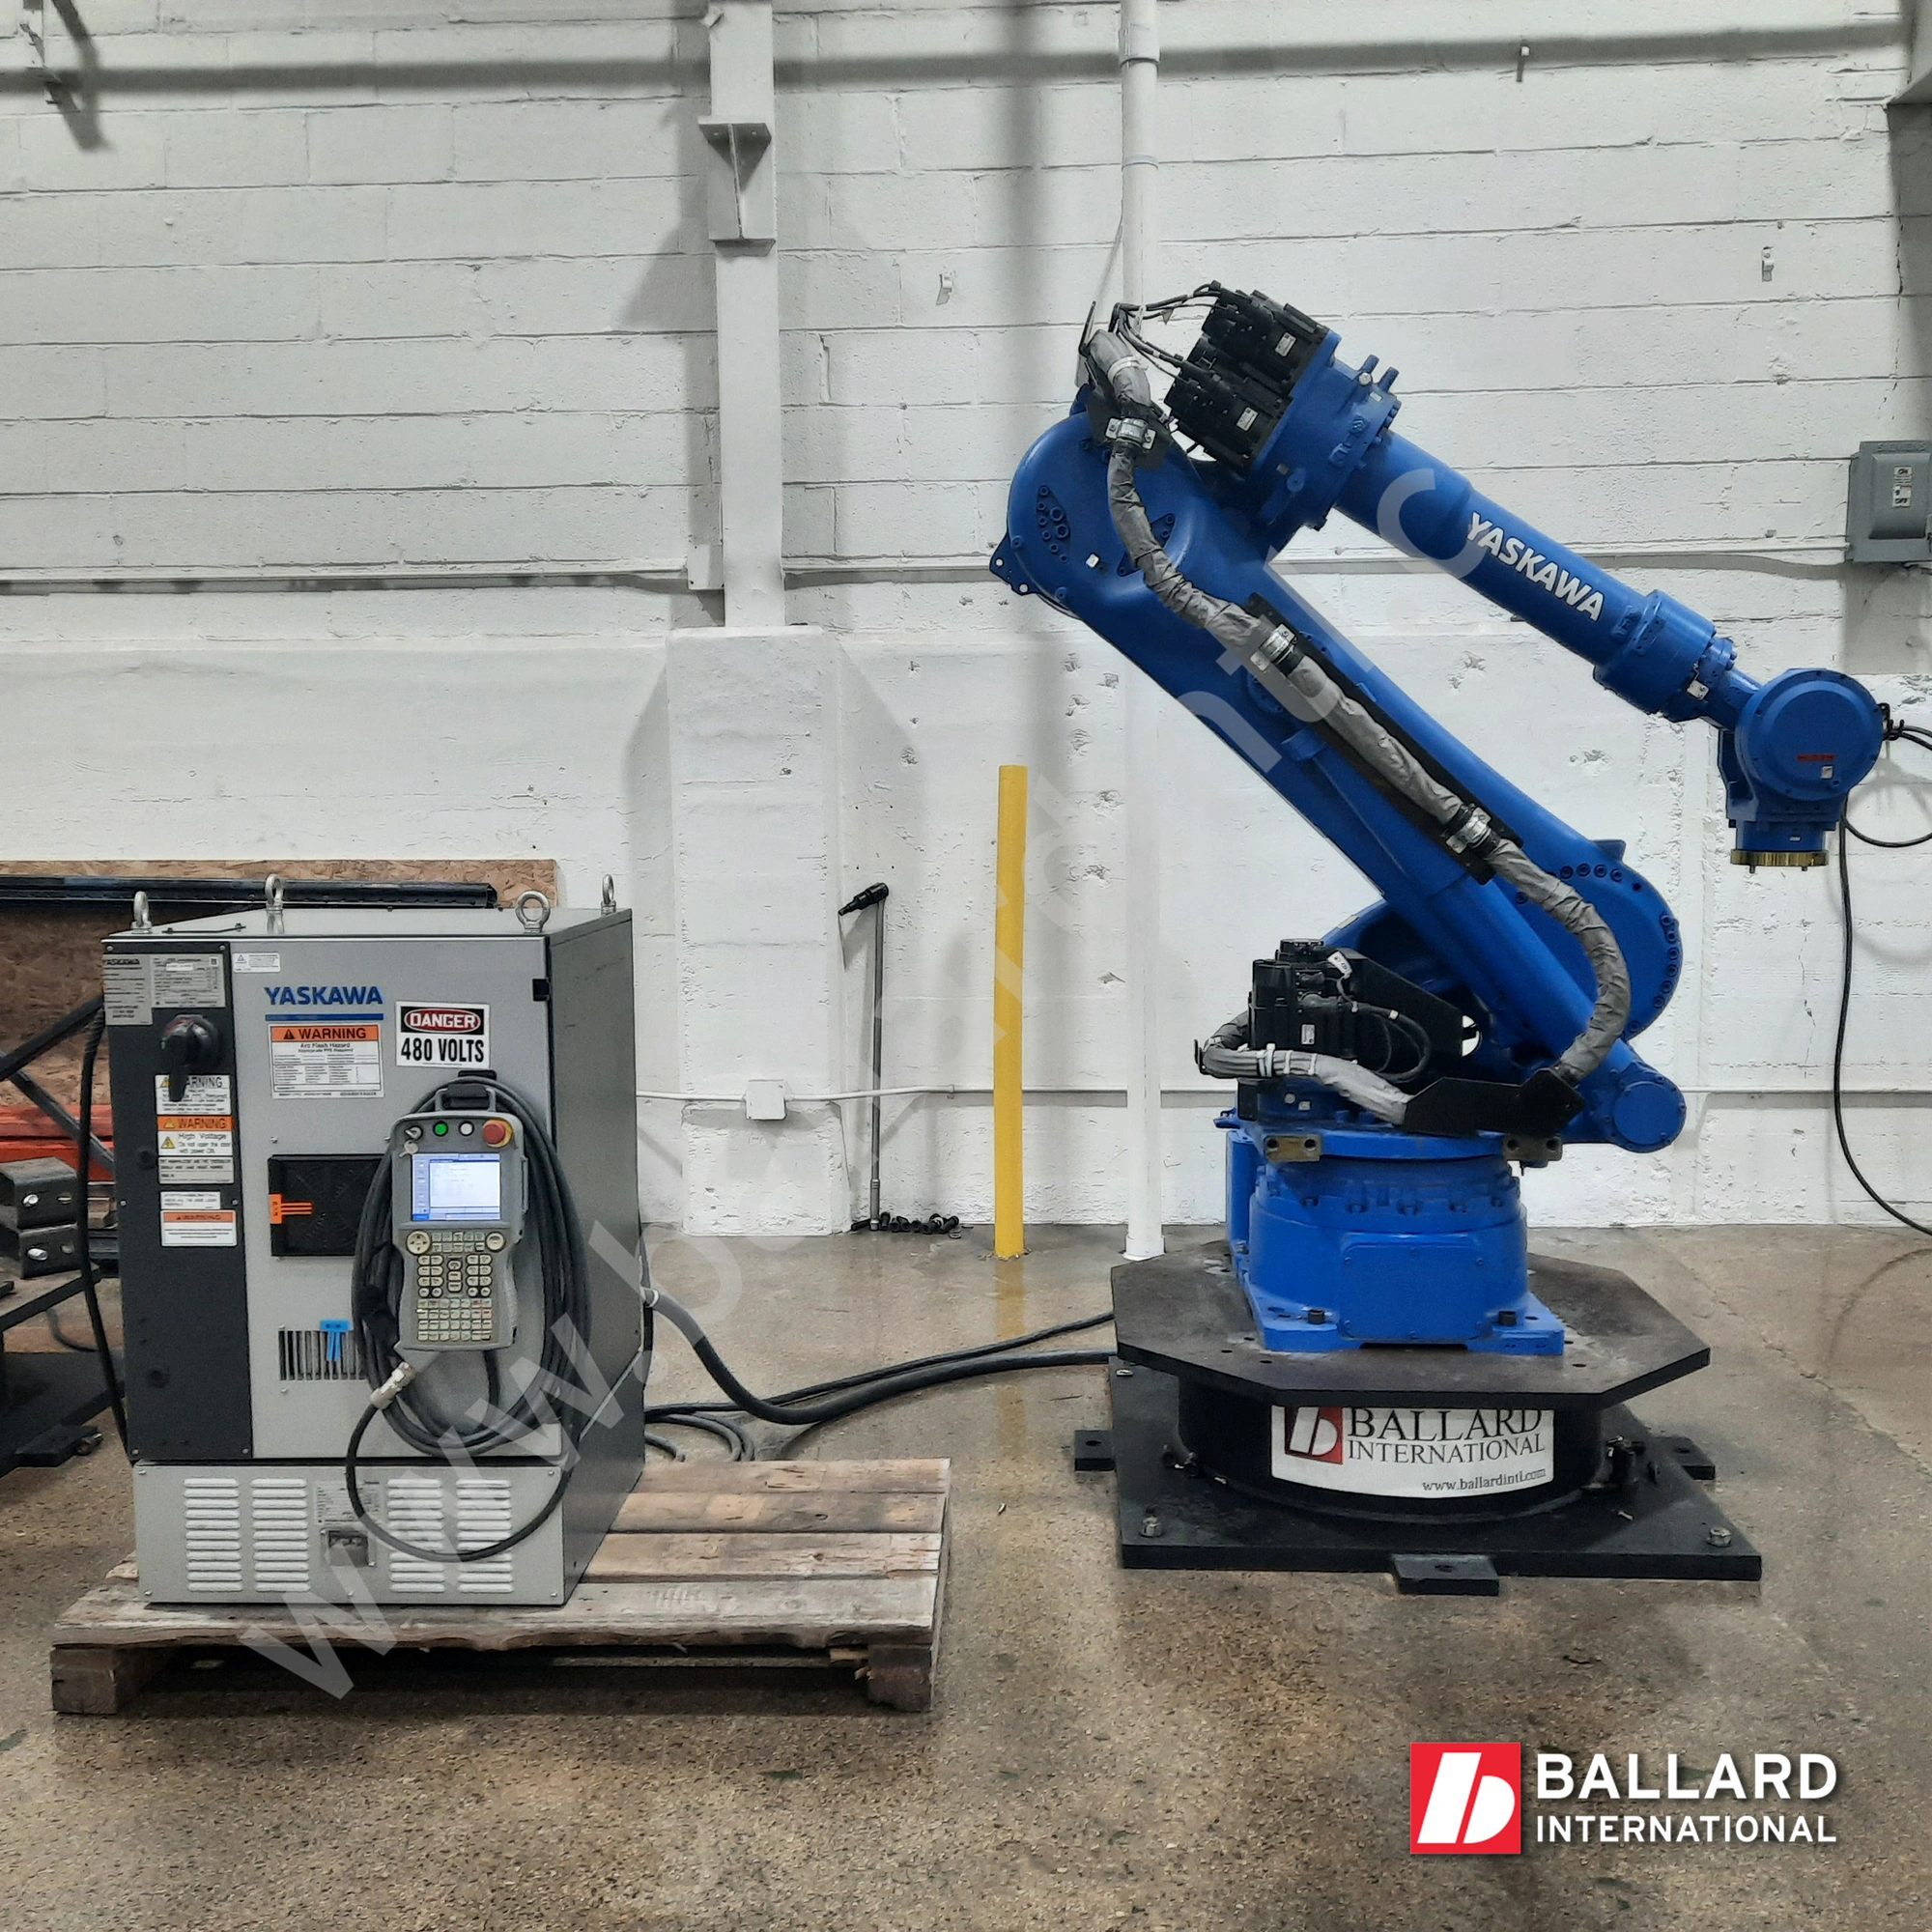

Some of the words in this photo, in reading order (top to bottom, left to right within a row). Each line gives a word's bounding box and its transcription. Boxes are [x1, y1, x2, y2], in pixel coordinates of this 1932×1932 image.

[1466, 512, 1605, 622] YASKAWA
[264, 985, 384, 1006] YASKAWA
[410, 1011, 475, 1029] DANGER
[298, 1027, 367, 1040] WARNING
[401, 1037, 433, 1062] 480
[438, 1038, 484, 1063] VOLTS
[185, 1076, 223, 1089] ARNING
[178, 1118, 227, 1129] WARNING
[1348, 1406, 1543, 1442] BALLARD
[1348, 1433, 1546, 1464] INTERNATIONAL
[1422, 1468, 1547, 1492] www.ballardintl.com
